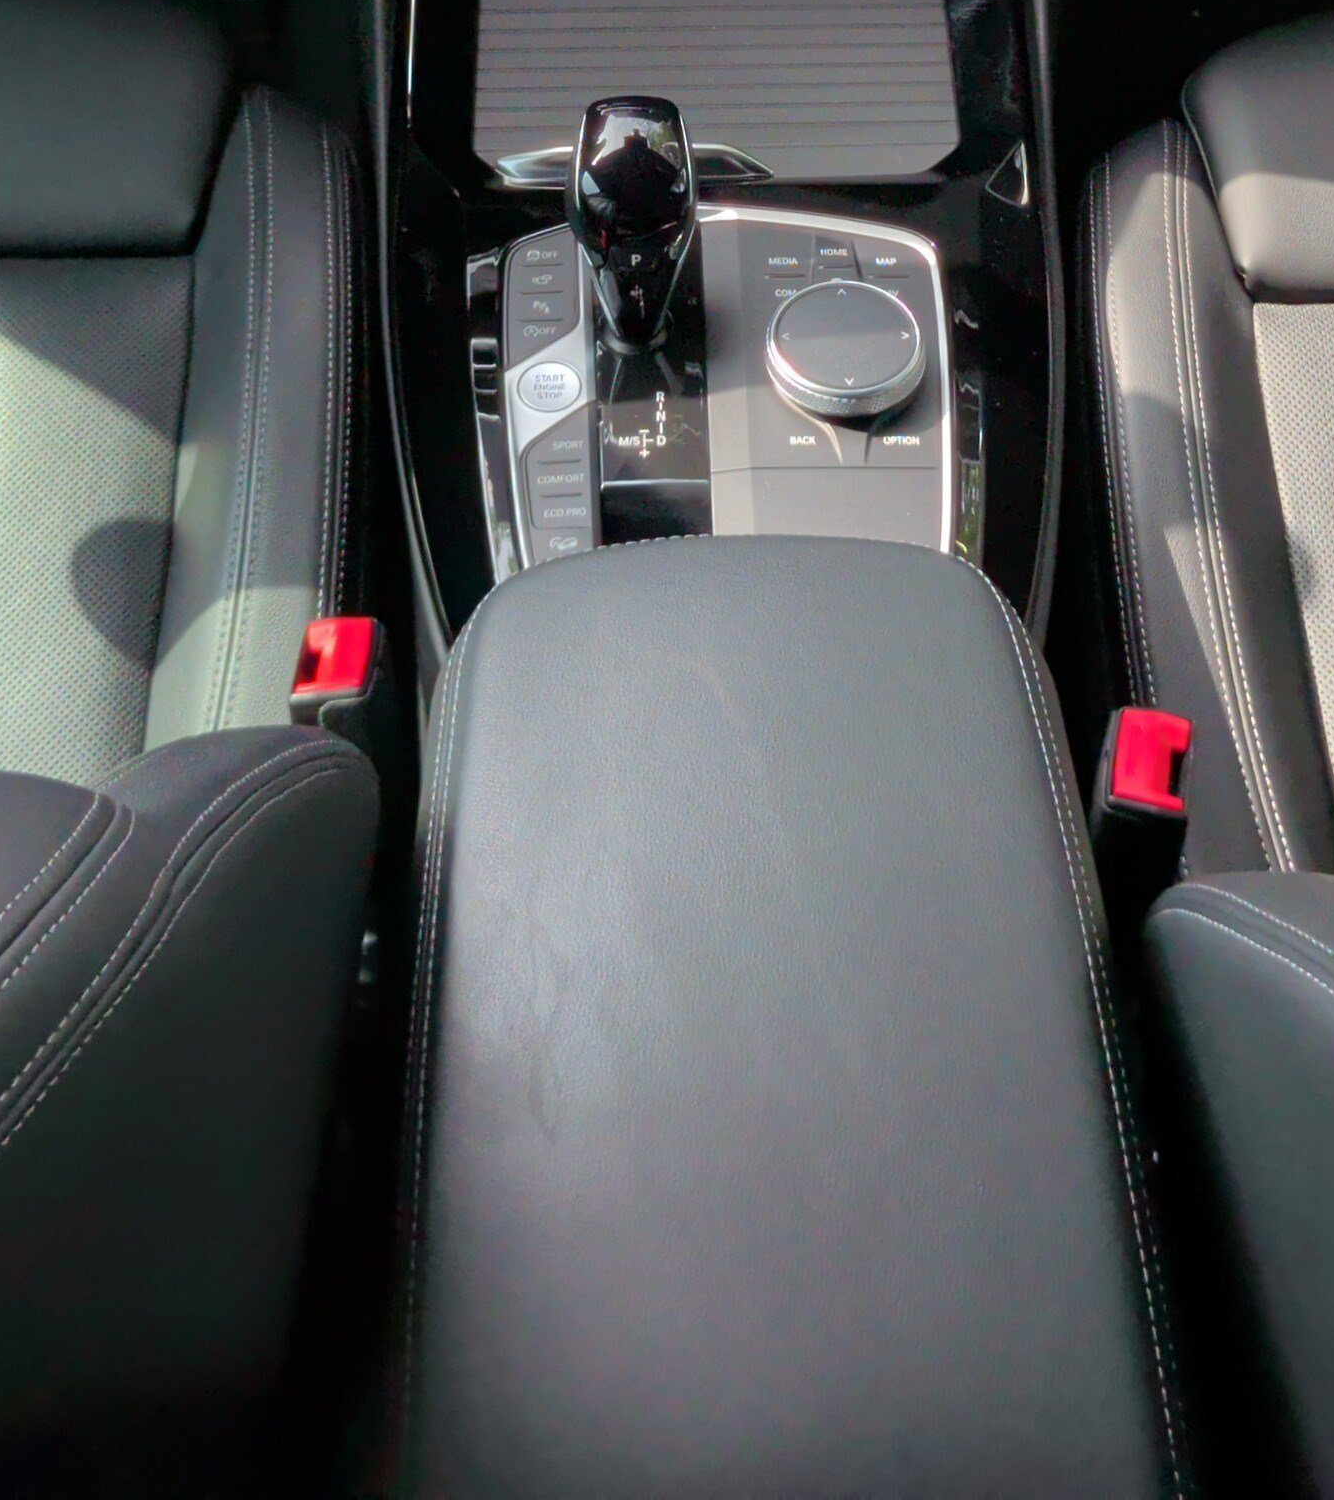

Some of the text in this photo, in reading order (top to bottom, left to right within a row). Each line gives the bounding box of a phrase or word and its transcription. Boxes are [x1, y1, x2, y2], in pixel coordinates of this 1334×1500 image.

[541, 251, 559, 259] OFF
[820, 248, 848, 257] HOME
[631, 254, 641, 267] P
[768, 257, 798, 266] MEDIA
[875, 257, 897, 266] MAP
[539, 326, 556, 335] OFF
[534, 374, 565, 383] START
[533, 382, 566, 391] ENGINE
[537, 391, 563, 400] STOP
[656, 391, 665, 401] R
[656, 411, 666, 422] N
[553, 440, 584, 450] SPORT
[618, 436, 666, 447] M/S D
[789, 436, 816, 446] BACK
[883, 436, 920, 446] OPTION
[537, 473, 586, 485] COMFORT
[543, 507, 587, 519] ECO PRO
